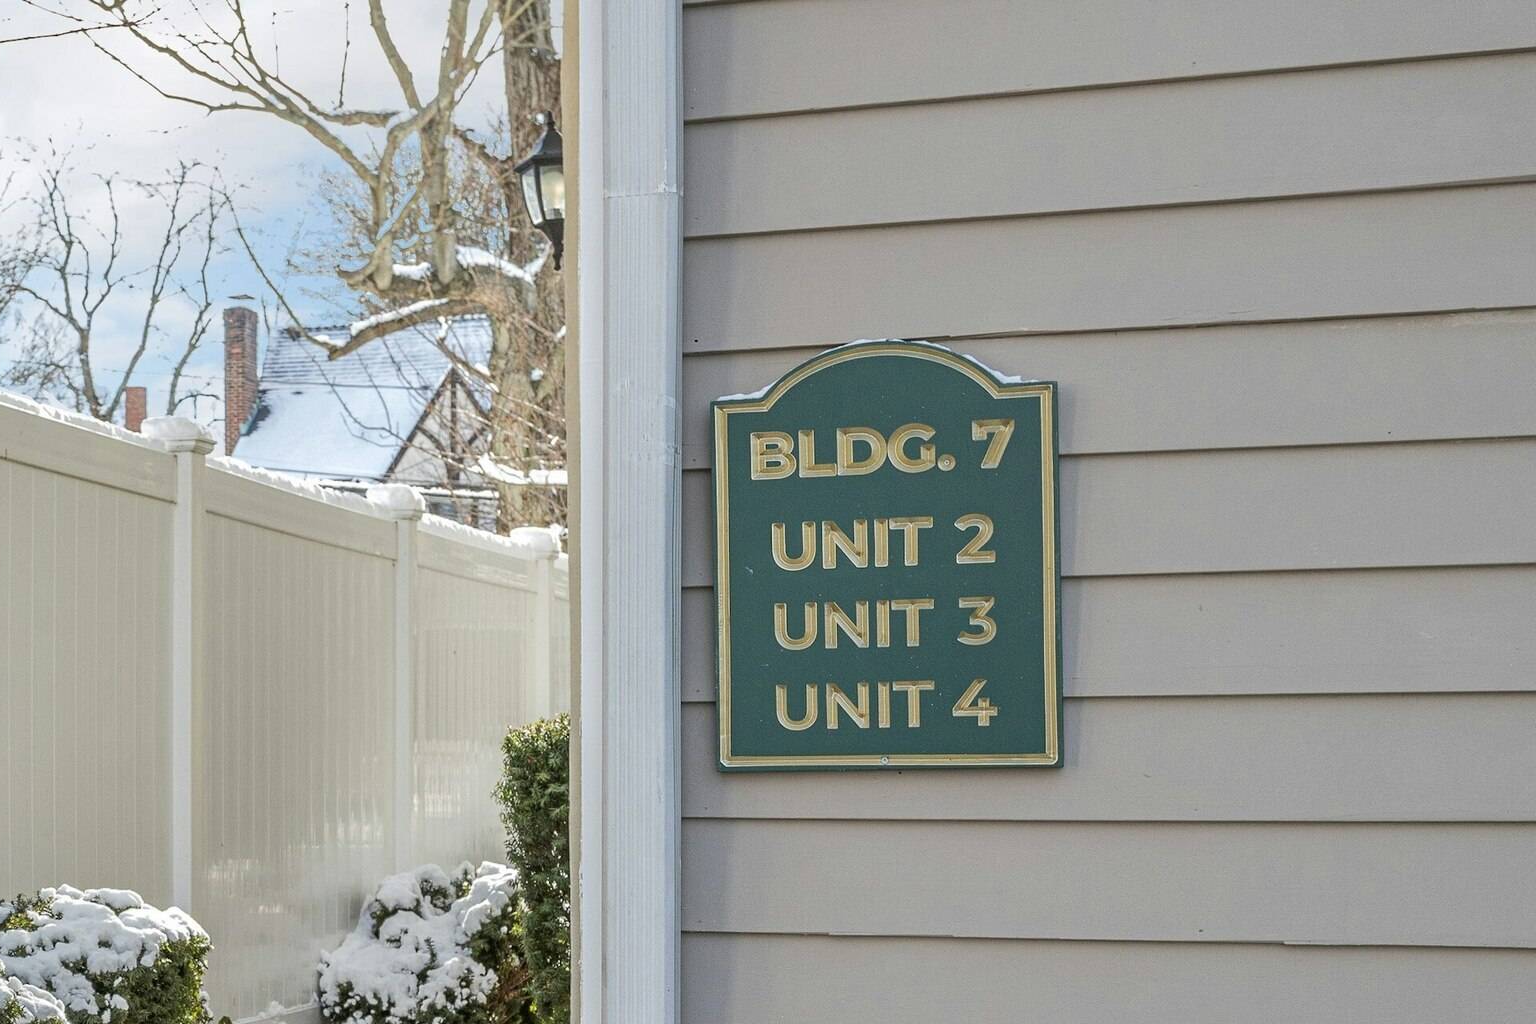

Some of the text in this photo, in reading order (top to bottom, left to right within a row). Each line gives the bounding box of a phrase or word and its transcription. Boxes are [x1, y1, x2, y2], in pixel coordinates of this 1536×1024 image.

[751, 418, 1015, 480] BLDG. 7
[771, 513, 996, 572] UNIT 2
[773, 597, 997, 651] UNIT 3
[775, 679, 999, 731] UNIT 4
